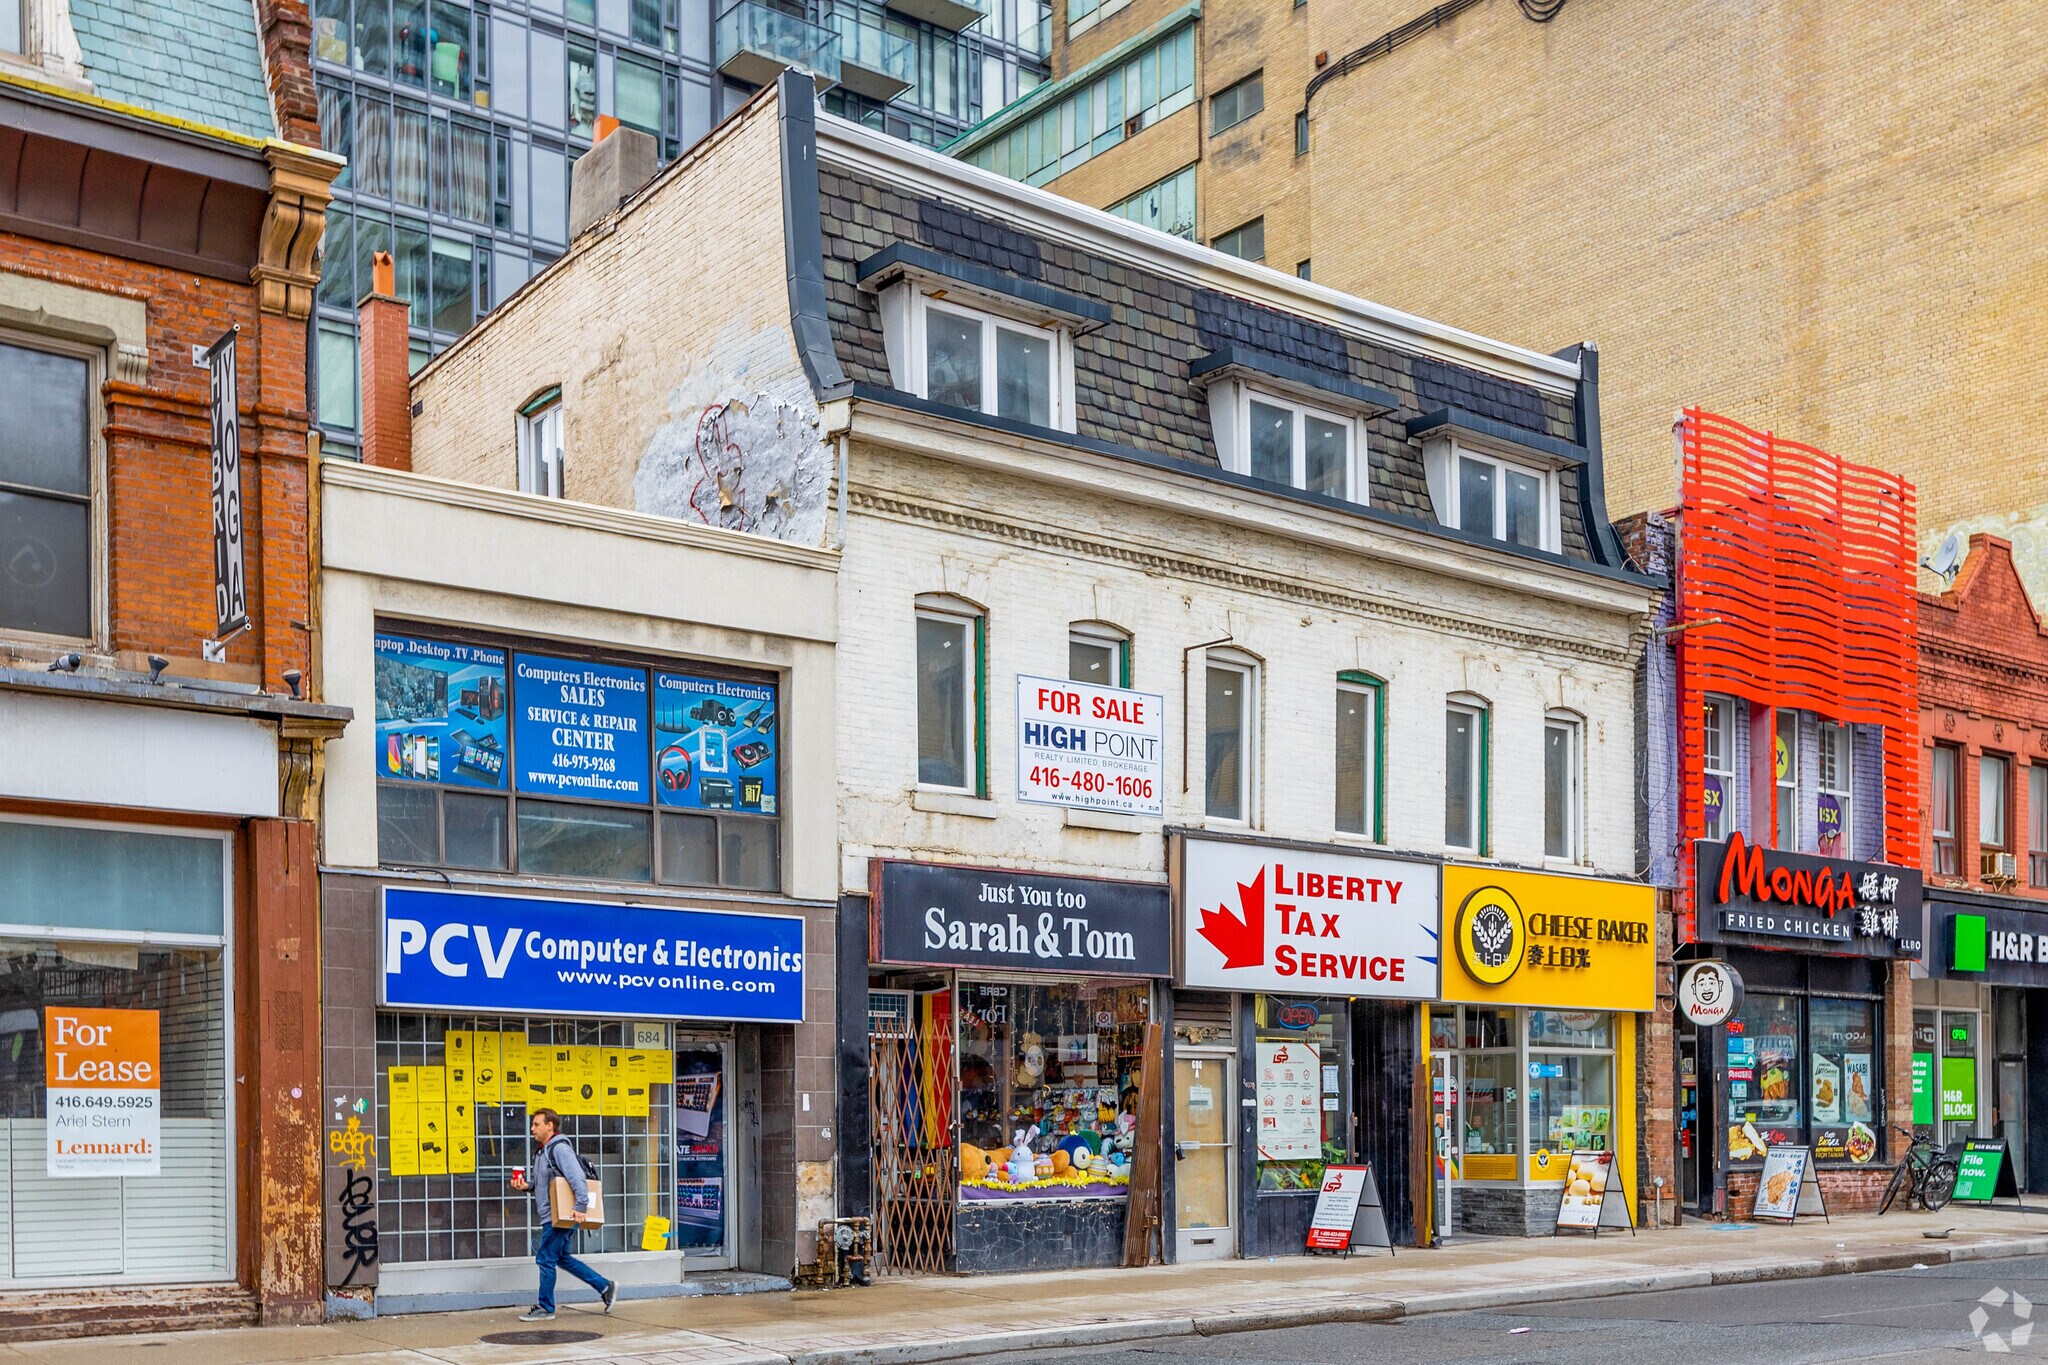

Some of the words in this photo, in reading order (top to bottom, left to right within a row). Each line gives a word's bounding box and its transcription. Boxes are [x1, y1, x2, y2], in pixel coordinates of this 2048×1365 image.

[210, 361, 229, 625] HYBRID
[222, 346, 244, 622] YOGA
[518, 664, 580, 684] Computers
[584, 672, 645, 692] Electronics
[659, 675, 713, 694] Computers
[717, 683, 771, 701] Electronics
[561, 685, 605, 707] SALES
[1038, 688, 1081, 715] FOR
[1093, 697, 1144, 724] SALE
[528, 707, 577, 725] SERVICE
[580, 714, 590, 726] &
[594, 715, 637, 732] REPAIR
[552, 728, 615, 751] CENTER
[1024, 722, 1086, 751] HIGH
[1095, 731, 1158, 760] POINT
[552, 753, 615, 772] 416-975-9268
[1035, 752, 1063, 762] REALTY
[1103, 761, 1148, 772] BROKERAGE
[528, 772, 639, 791] www.pcvonline.com
[1030, 766, 1152, 798] 416-480-1606
[1052, 793, 1133, 808] www.highpoint.ca
[1275, 864, 1403, 904] LIBERTY
[978, 883, 1014, 904] Just
[1018, 886, 1052, 907] You
[1056, 888, 1086, 910] too
[1275, 903, 1340, 939] TAX
[1528, 913, 1593, 940] CHEESE
[1597, 919, 1649, 944] BAKER
[1727, 913, 1775, 930] FRIED
[1784, 919, 1850, 938] CHICKEN
[924, 907, 1030, 954] Sarah
[1034, 912, 1062, 958] &
[1064, 917, 1136, 960] Tom
[1901, 938, 1921, 950] LLBO
[386, 918, 523, 979] PCV
[524, 930, 648, 970] Computer
[652, 939, 670, 966] &
[674, 940, 802, 973] Electronics
[1991, 930, 2033, 962] H&R
[1274, 944, 1405, 982] SERVICE
[557, 970, 776, 994] www.pcvonline.com
[1280, 1006, 1317, 1026] OPEN
[54, 1017, 112, 1046] For
[637, 1031, 660, 1043] 684
[1952, 1028, 1967, 1041] OPEN
[55, 1052, 152, 1082] Lease
[1273, 1055, 1288, 1063] LSP
[1847, 1063, 1867, 1073] WASABI
[55, 1096, 153, 1108] 416.649.5925
[1944, 1090, 1962, 1102] H&R
[1944, 1103, 1972, 1116] BLOCK
[55, 1115, 87, 1128] Ariel
[55, 1139, 152, 1154] Lennard:
[1963, 1155, 1983, 1165] File
[1960, 1167, 1986, 1177] now.
[1323, 1182, 1342, 1192] LSP
